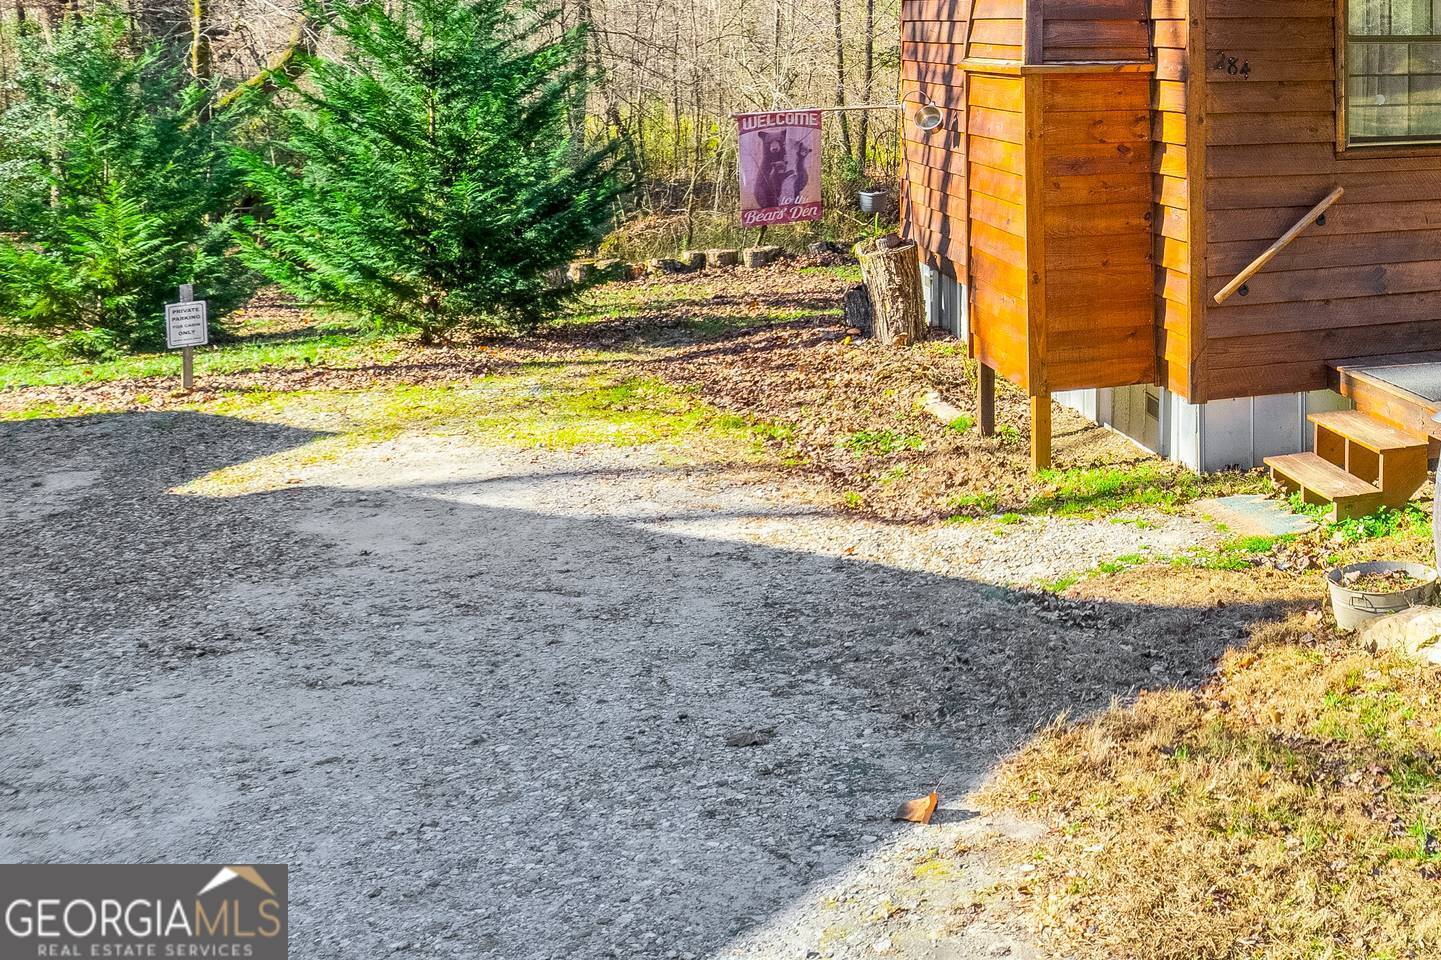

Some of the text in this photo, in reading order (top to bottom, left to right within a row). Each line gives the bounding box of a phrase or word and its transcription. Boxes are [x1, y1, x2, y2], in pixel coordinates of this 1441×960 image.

[742, 113, 818, 130] WELCOME
[780, 195, 793, 205] to
[789, 206, 818, 220] Den
